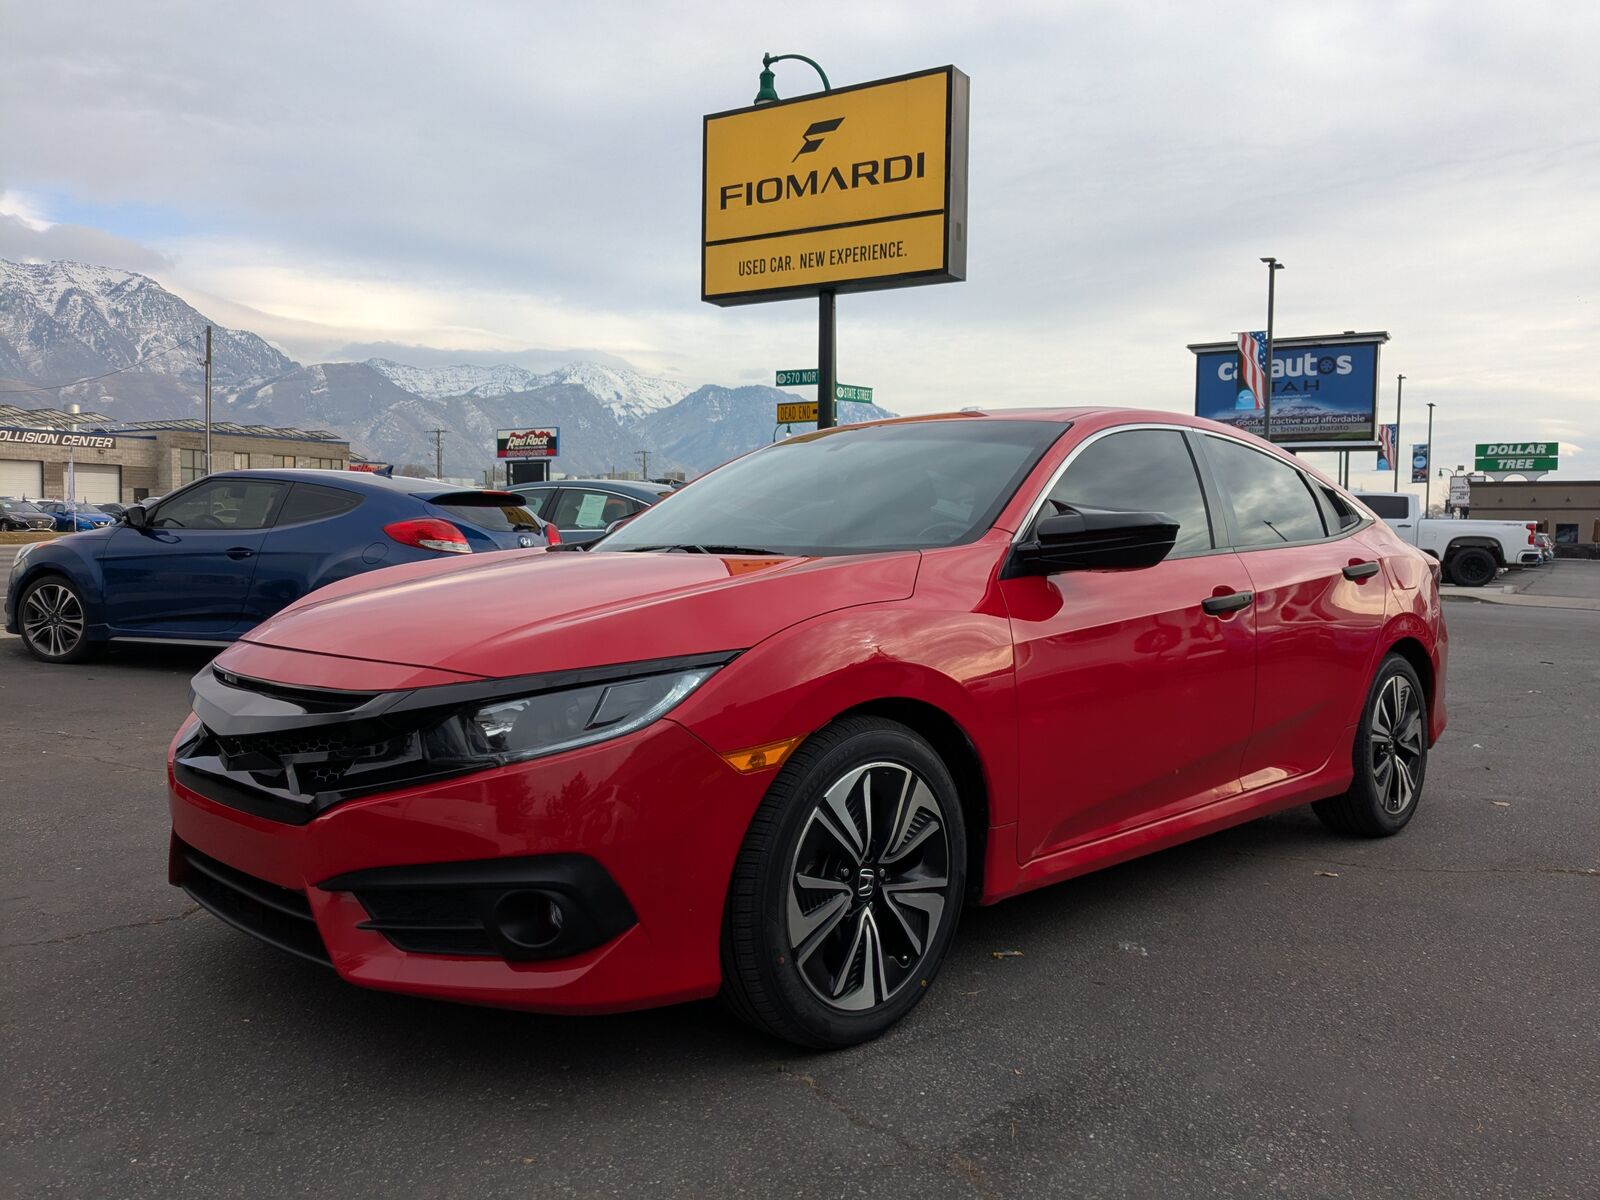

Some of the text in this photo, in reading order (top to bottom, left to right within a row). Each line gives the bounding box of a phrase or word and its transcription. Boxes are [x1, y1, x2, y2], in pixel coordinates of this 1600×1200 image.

[720, 152, 925, 210] FIOMARDI
[738, 241, 908, 276] USED CAR. NEW EXPERIENCE.
[786, 372, 800, 384] 570
[844, 386, 872, 401] STATE STREET
[1270, 379, 1320, 393] TAH
[780, 405, 810, 420] DEAD END
[1301, 416, 1319, 424] and
[1320, 415, 1365, 424] affordable
[0, 430, 114, 448] OLLISION CENTER
[506, 434, 549, 449] Red Rock
[1486, 443, 1547, 456] DOLLAR
[1497, 459, 1534, 470] TREE
